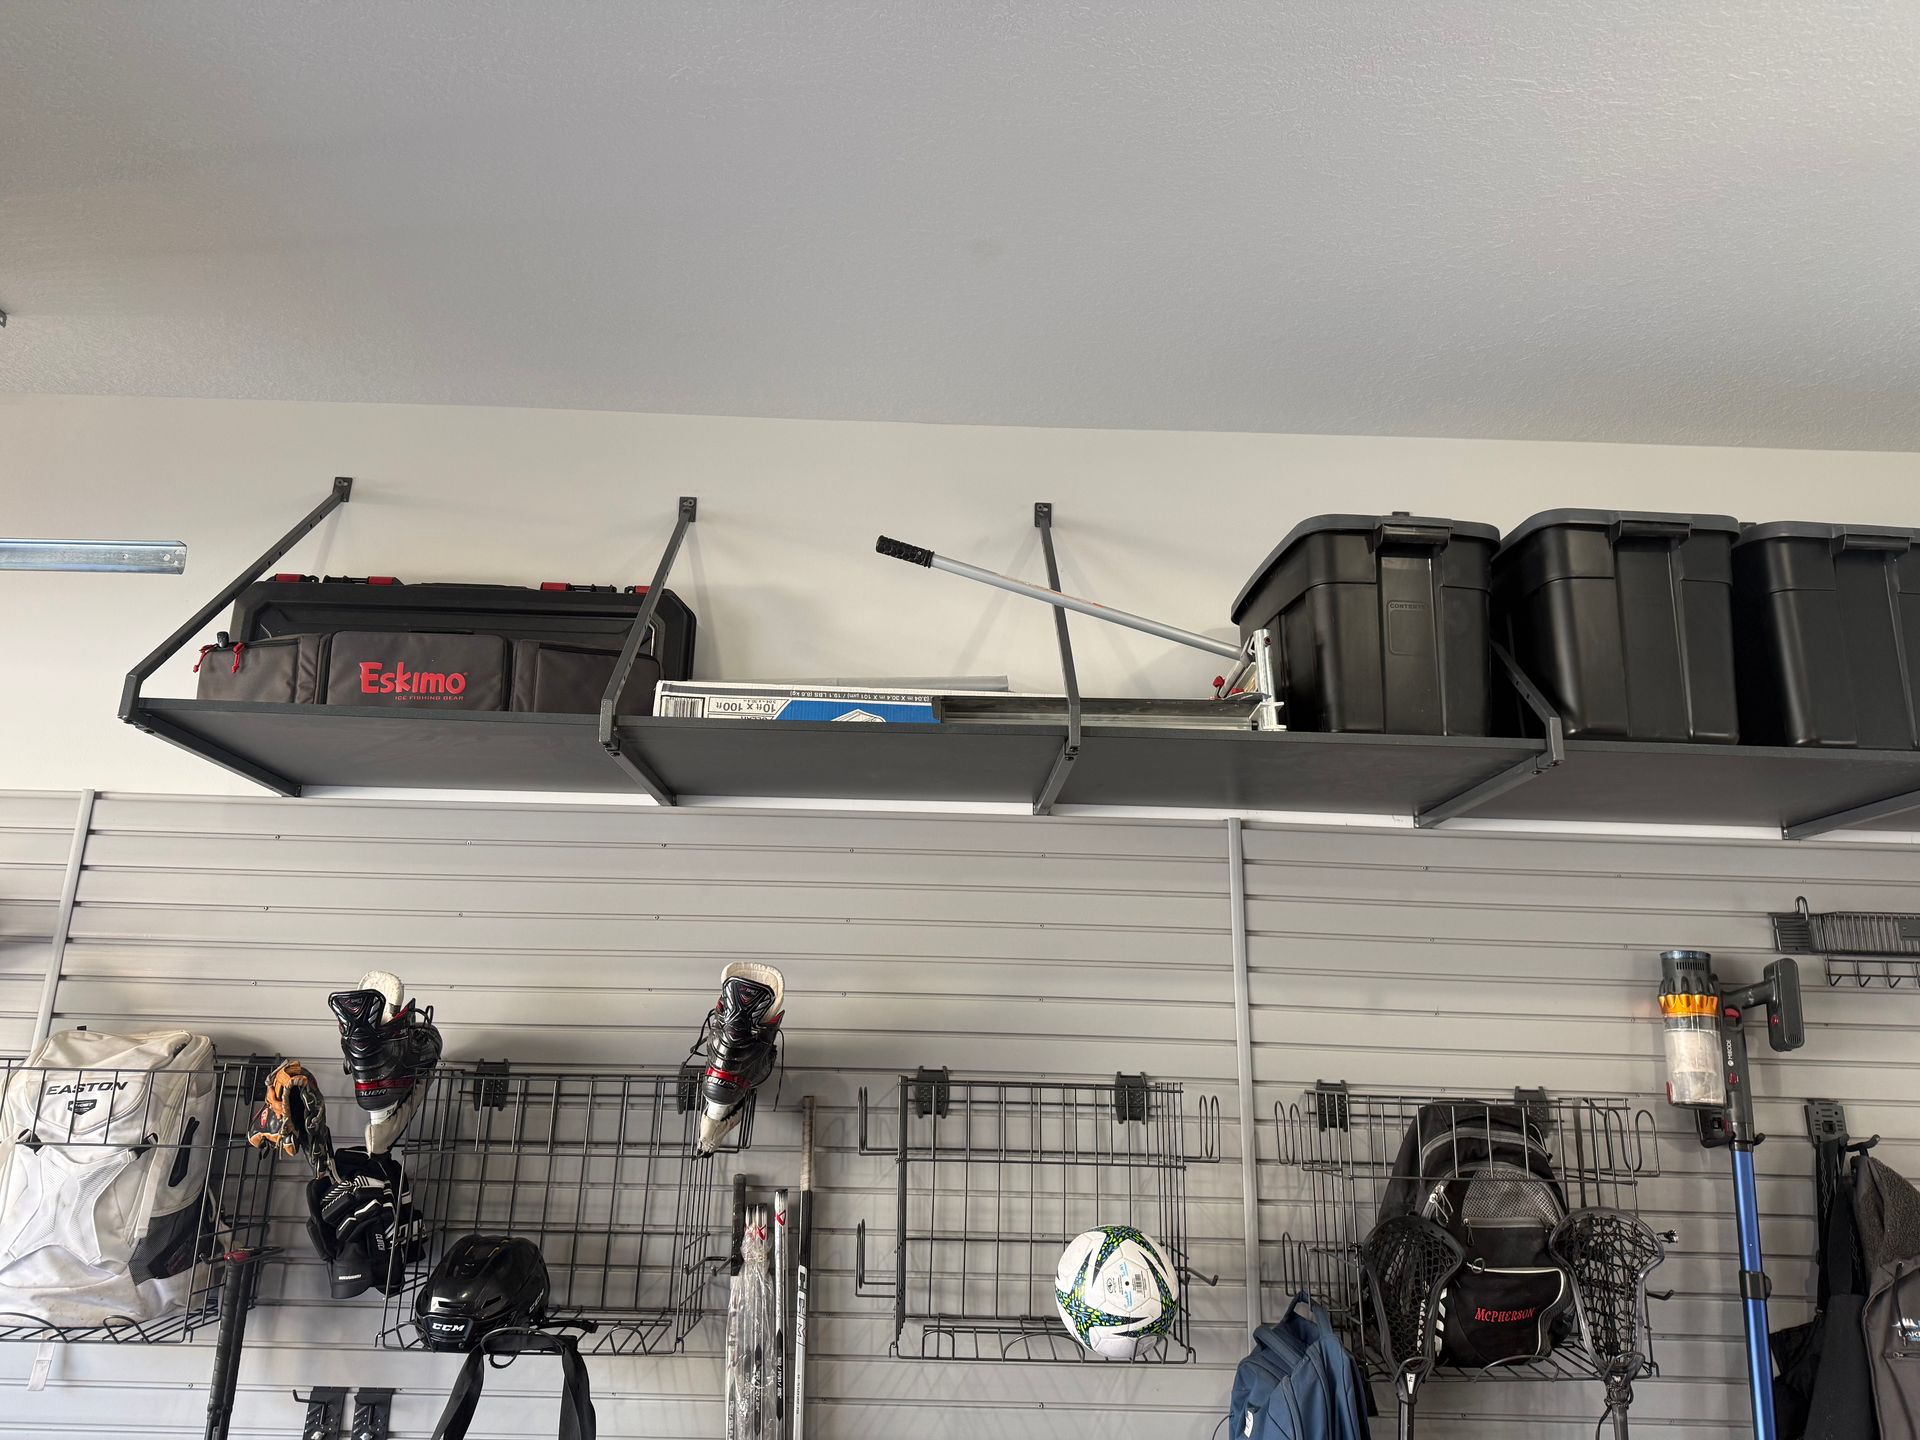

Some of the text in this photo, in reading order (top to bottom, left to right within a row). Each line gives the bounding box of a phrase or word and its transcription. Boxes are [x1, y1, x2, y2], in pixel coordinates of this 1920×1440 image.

[359, 661, 466, 695] Eskimo
[46, 1081, 129, 1096] EASTON
[795, 1264, 807, 1347] CCM
[431, 1321, 466, 1332] CCM
